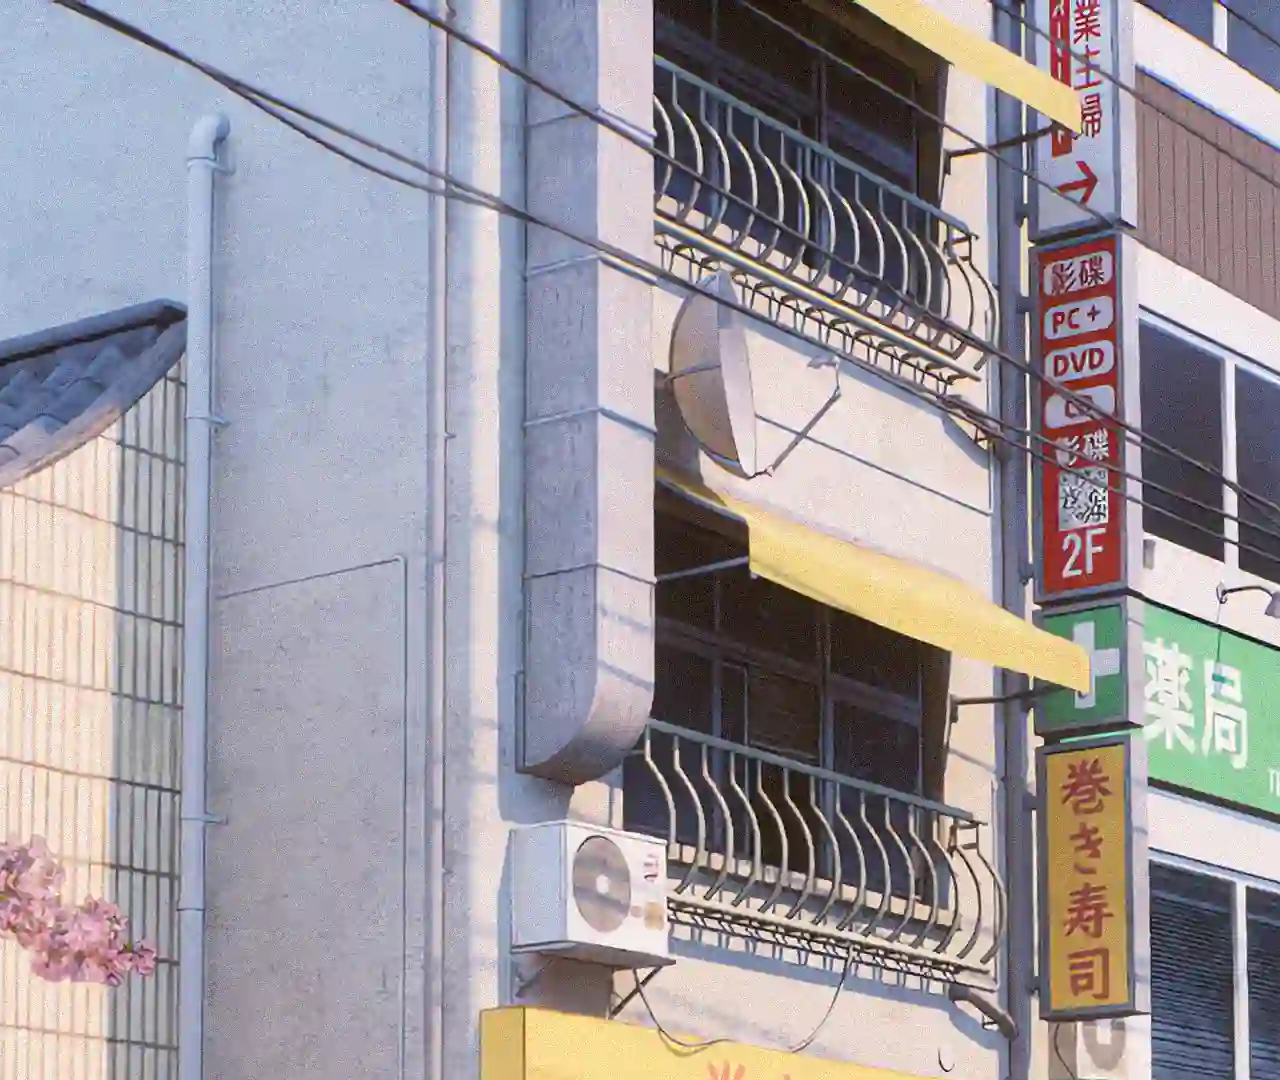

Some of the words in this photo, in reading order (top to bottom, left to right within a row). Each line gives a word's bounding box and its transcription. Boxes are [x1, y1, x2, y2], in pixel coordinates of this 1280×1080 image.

[1053, 348, 1105, 378] DVD
[1062, 527, 1107, 579] 2F
[1142, 636, 1248, 770] 薬局
[1061, 758, 1114, 1001] 巻き寿司
